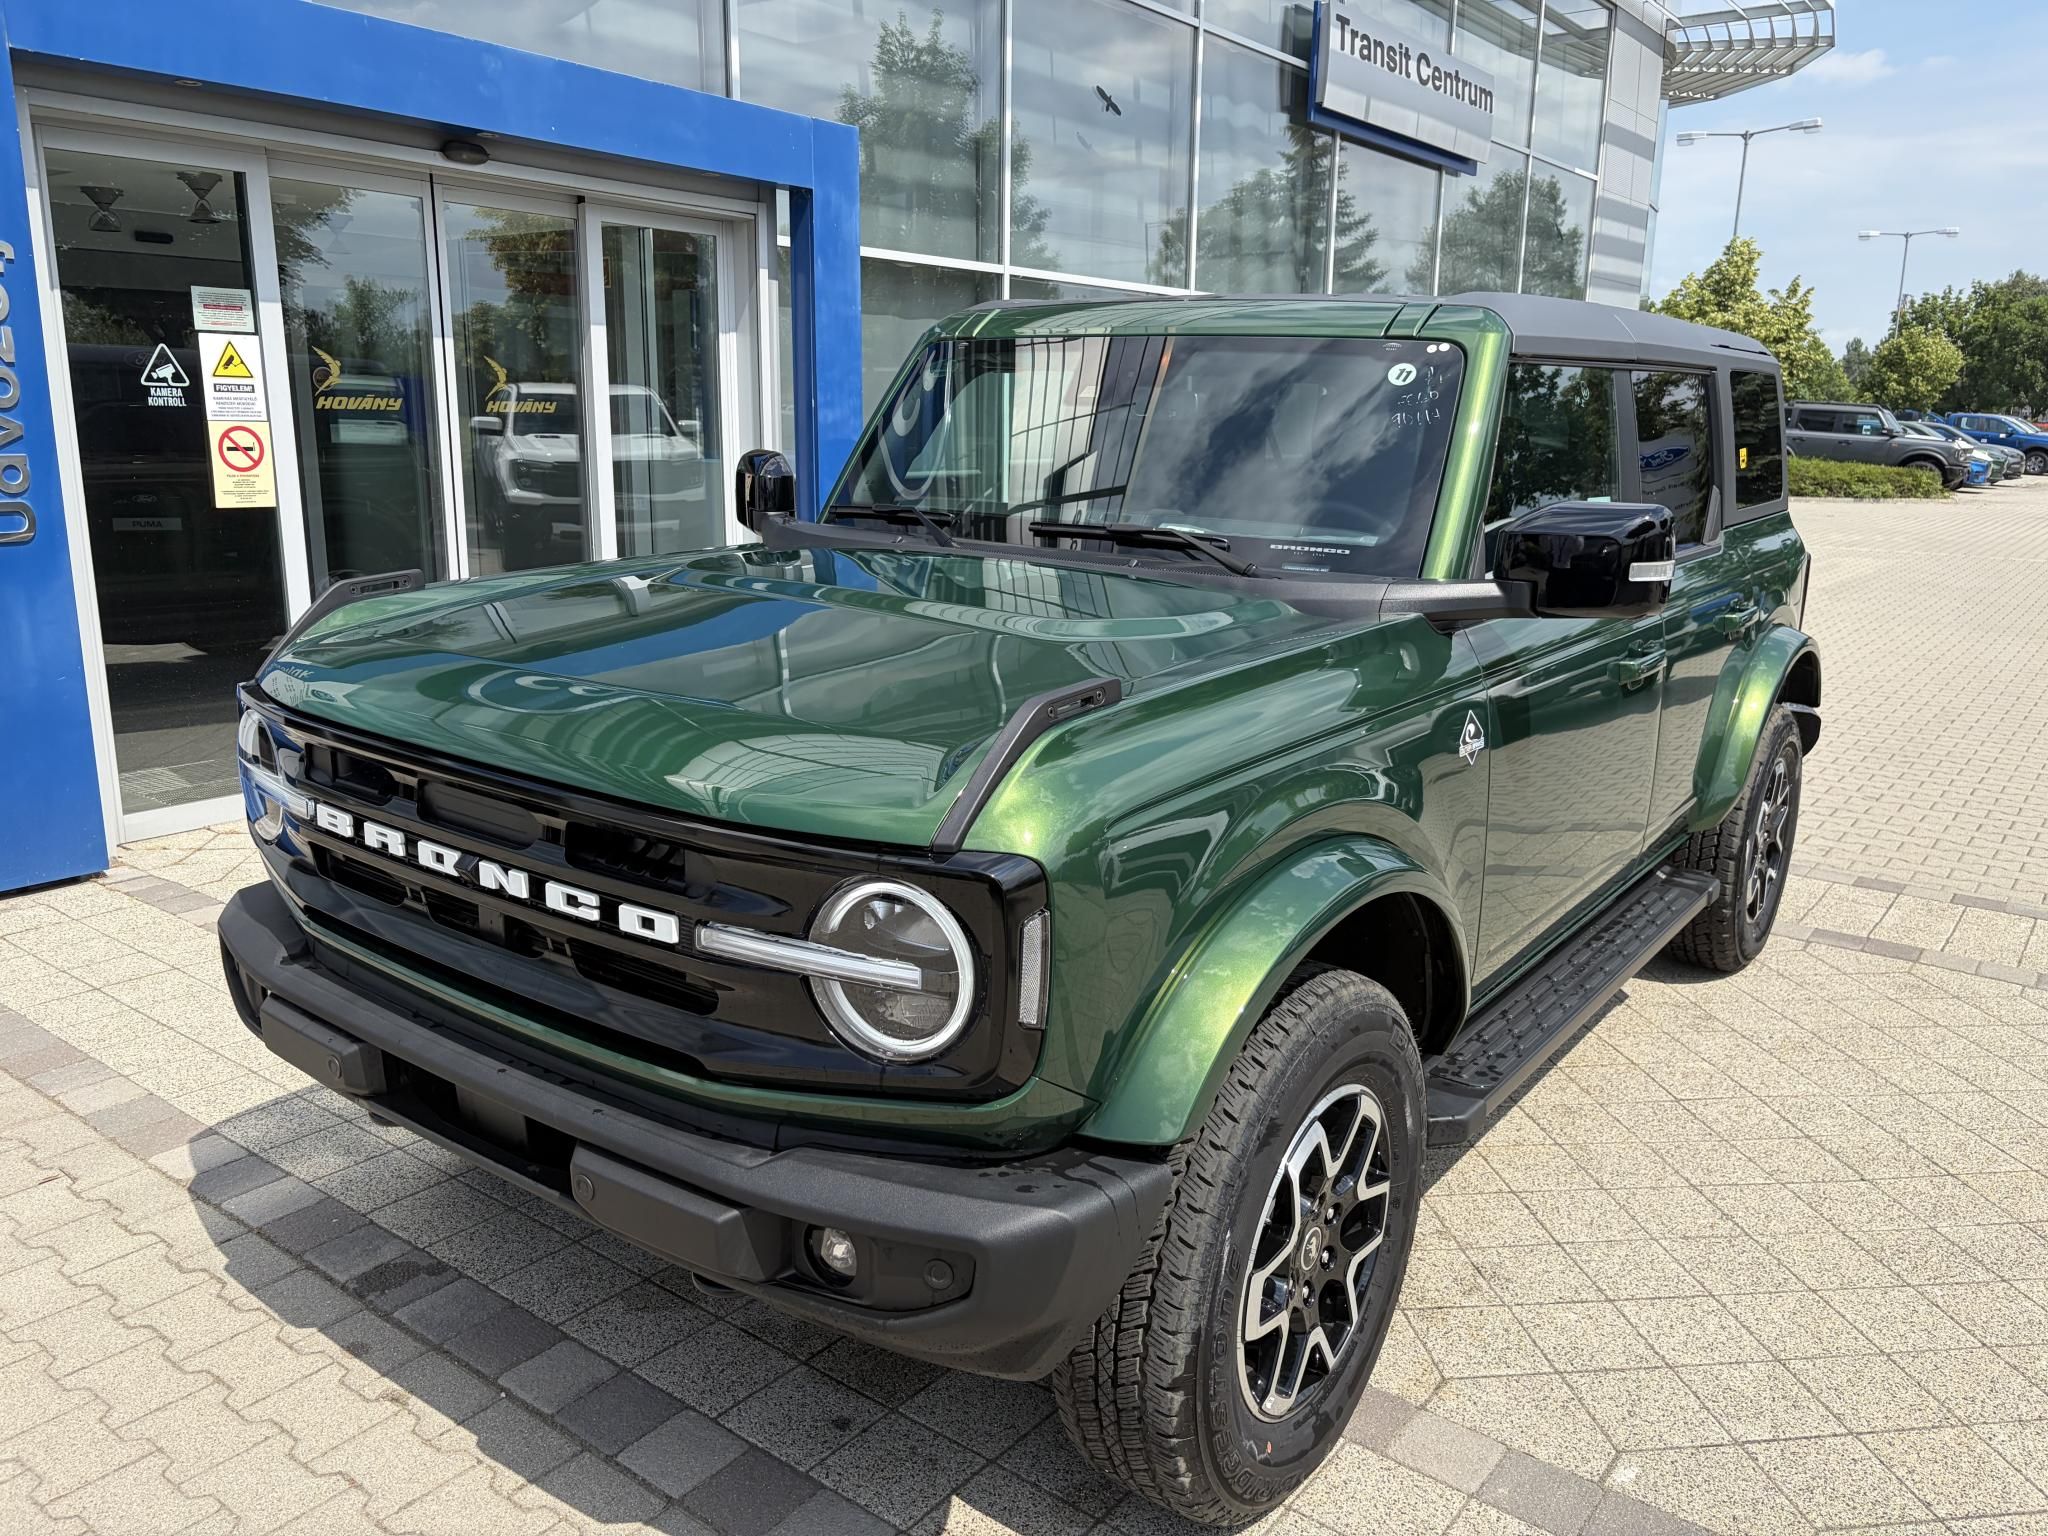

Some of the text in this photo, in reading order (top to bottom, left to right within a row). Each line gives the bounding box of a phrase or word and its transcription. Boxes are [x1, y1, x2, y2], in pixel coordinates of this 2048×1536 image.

[1335, 13, 1494, 114] Transit Centrum
[149, 387, 183, 397] KAMERA
[215, 384, 253, 393] FIGYELEM!
[147, 396, 187, 407] KONTROLL
[316, 394, 403, 411] HOVÁNY
[485, 398, 557, 414] HOVÁNY
[316, 803, 680, 944] BRONCO
